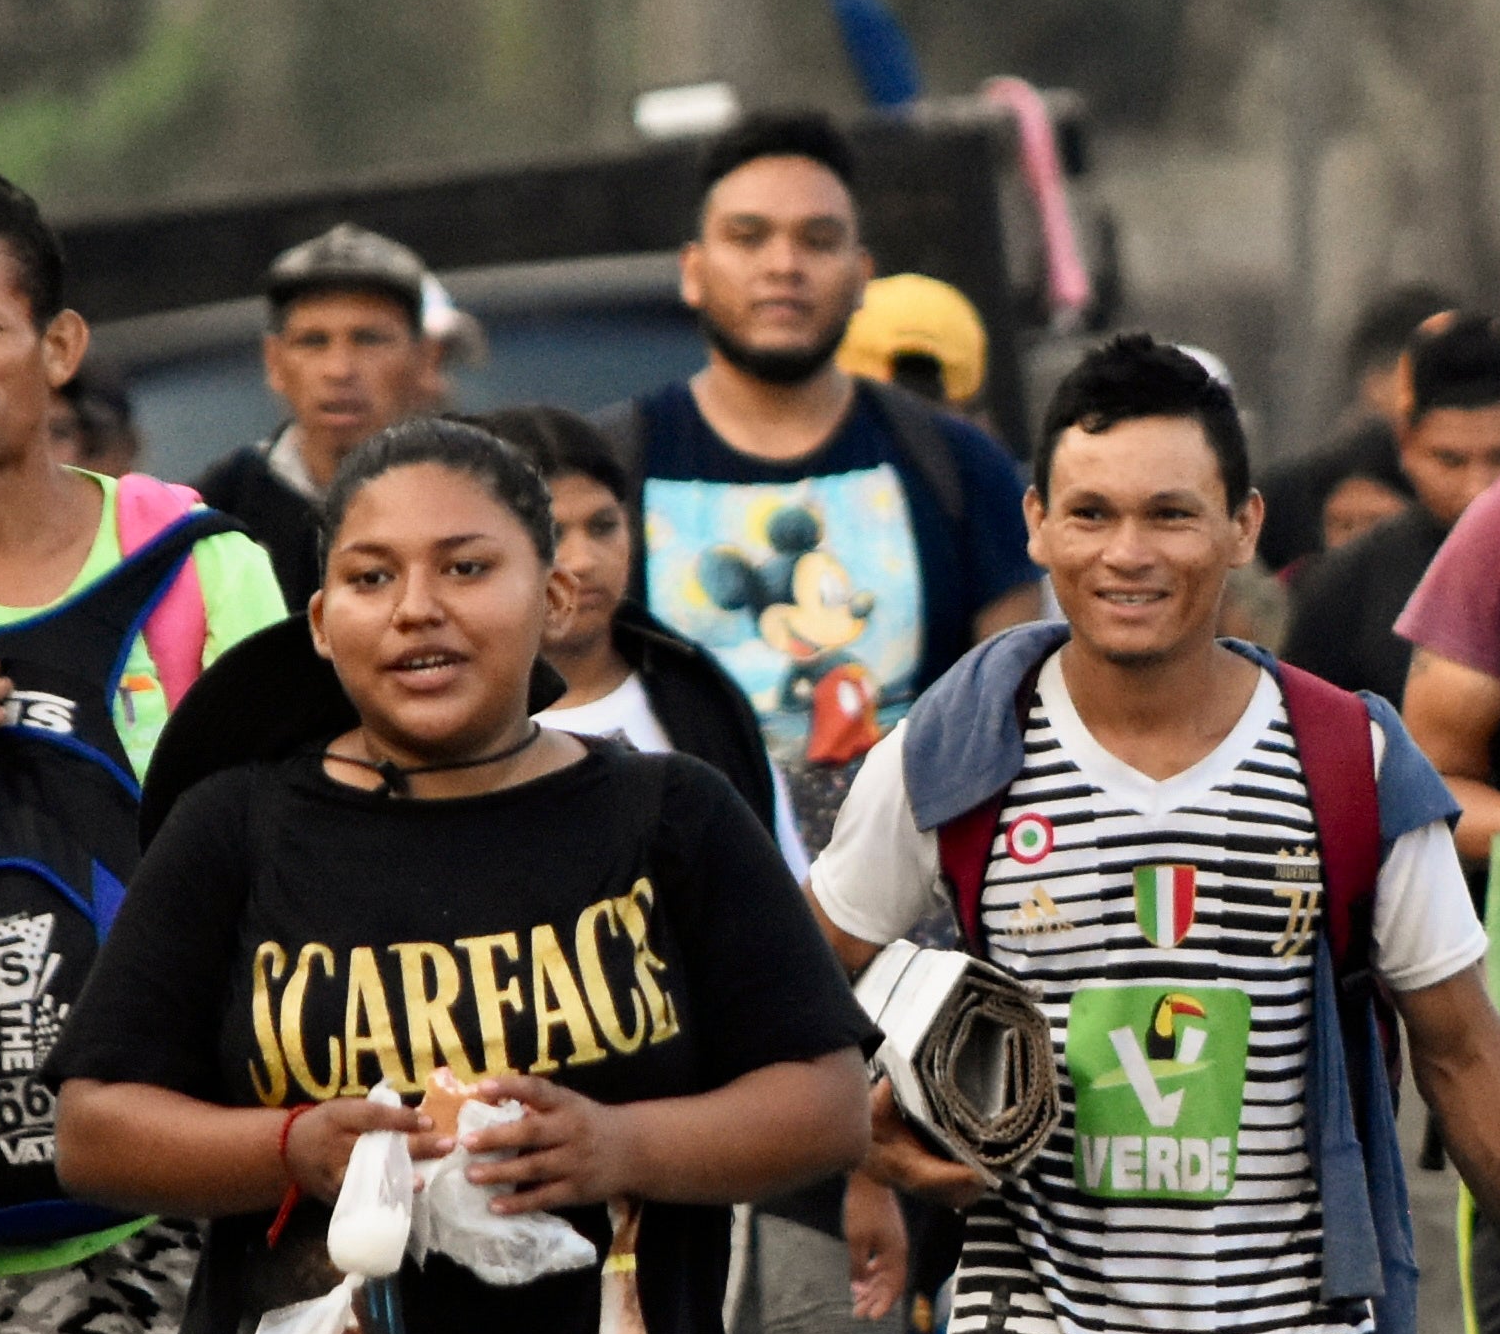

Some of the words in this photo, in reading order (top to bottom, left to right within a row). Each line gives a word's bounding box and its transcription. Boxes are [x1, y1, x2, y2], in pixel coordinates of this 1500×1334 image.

[1006, 920, 1074, 937] adidas
[247, 875, 681, 1107] SCARFACE
[0, 1002, 35, 1071] THE
[1079, 1135, 1231, 1193] VERDE
